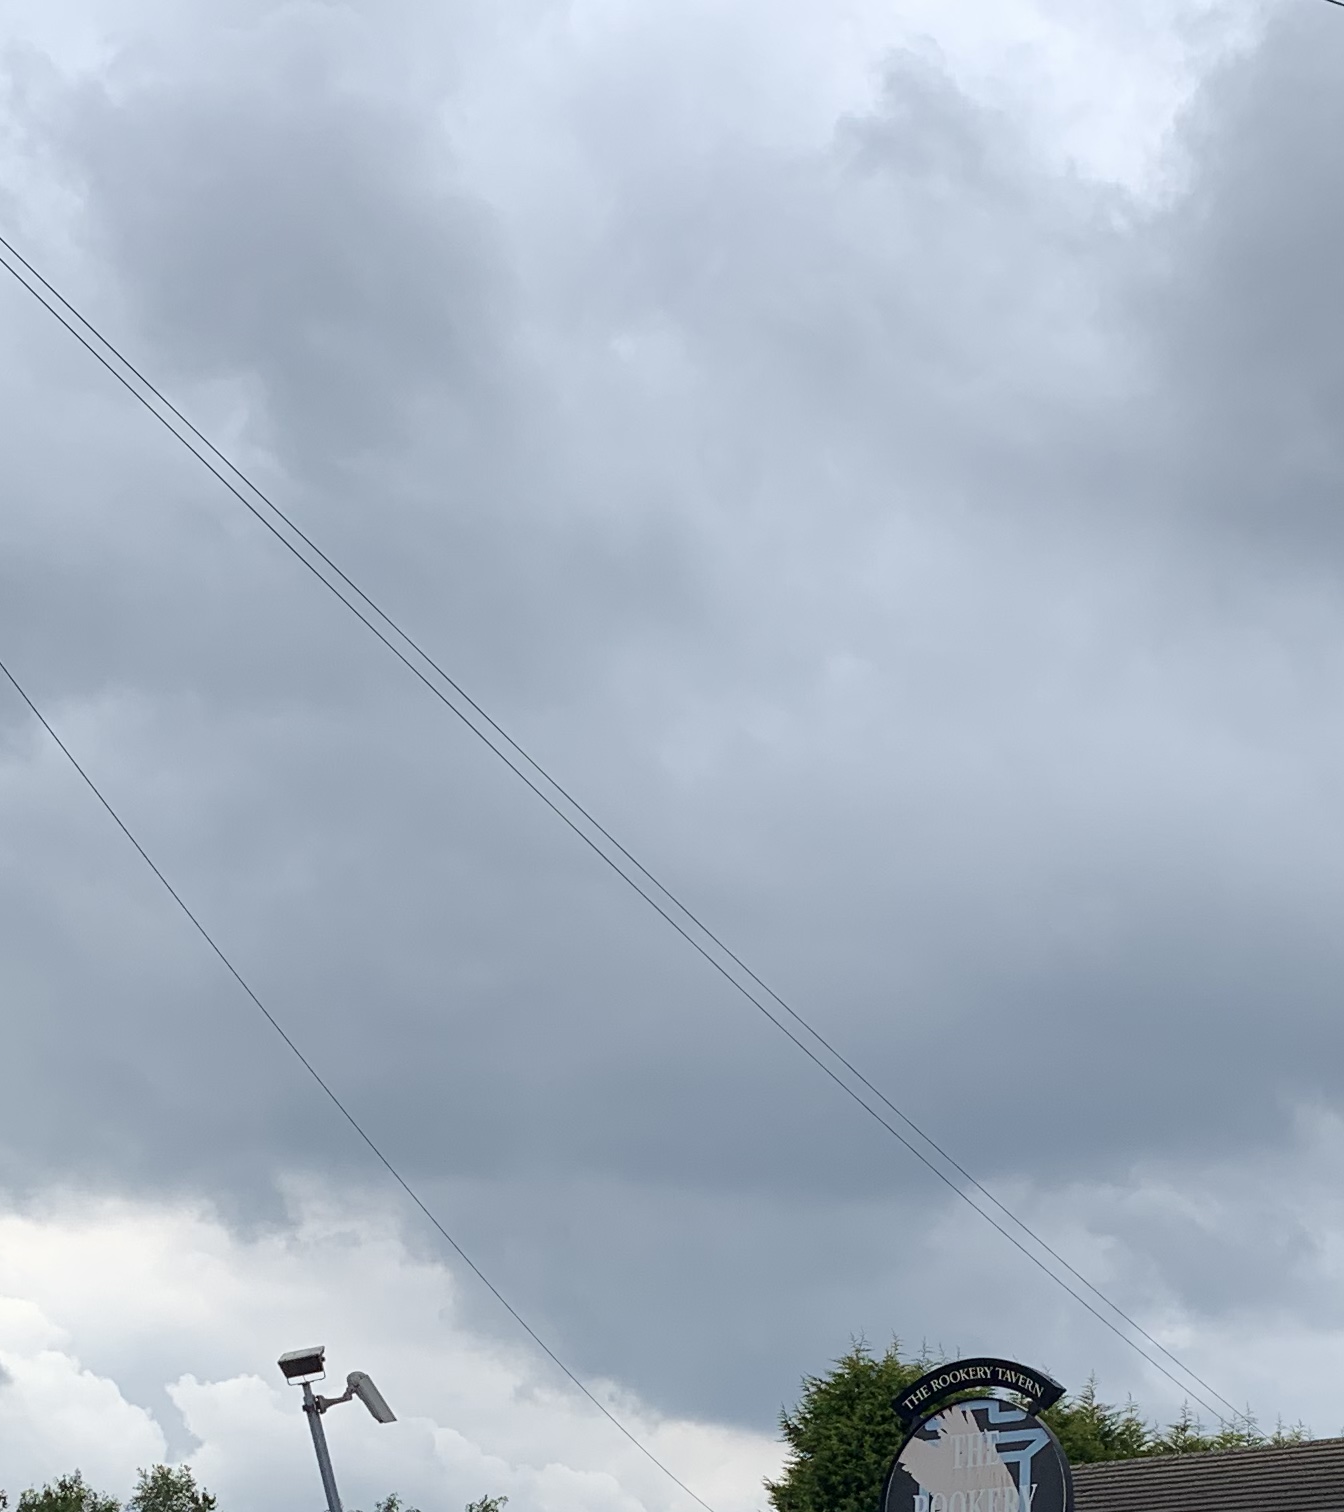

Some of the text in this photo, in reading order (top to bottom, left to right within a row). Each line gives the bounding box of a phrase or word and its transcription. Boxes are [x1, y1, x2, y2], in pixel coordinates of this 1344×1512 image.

[902, 1366, 1045, 1410] THE ROOKERY TAVERN
[951, 1429, 1000, 1470] THE
